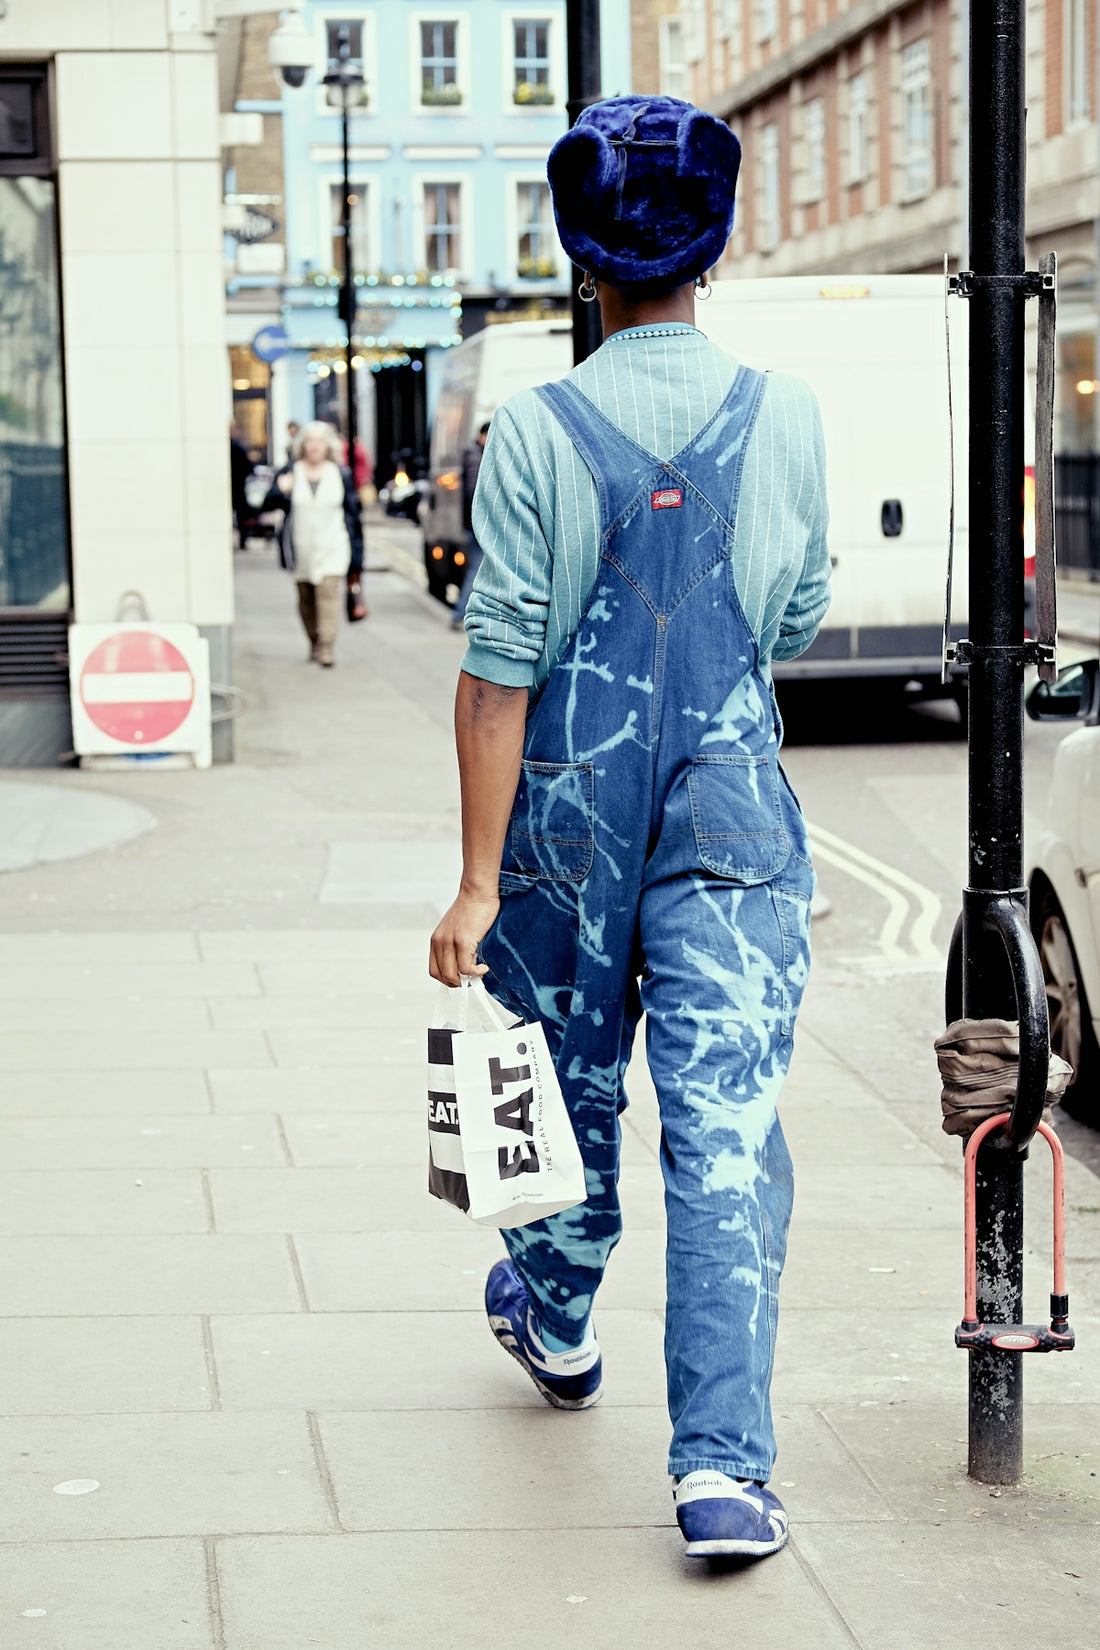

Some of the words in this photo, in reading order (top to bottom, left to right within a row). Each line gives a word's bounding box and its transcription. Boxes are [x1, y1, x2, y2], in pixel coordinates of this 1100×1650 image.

[530, 1041, 543, 1088] COMPANY
[488, 1042, 539, 1180] EAT.
[539, 1127, 550, 1152] REAL
[545, 1156, 553, 1172] THE
